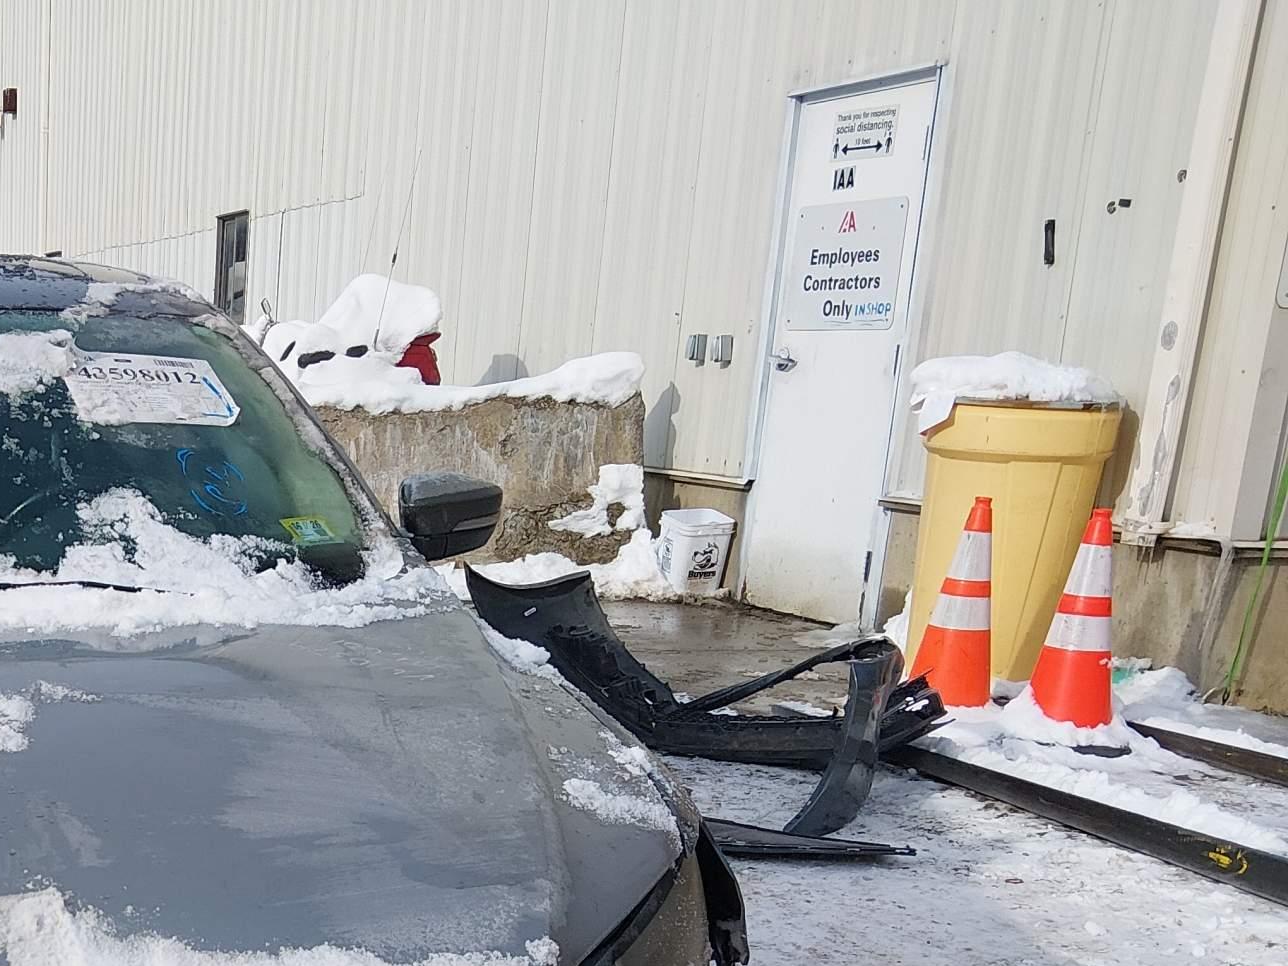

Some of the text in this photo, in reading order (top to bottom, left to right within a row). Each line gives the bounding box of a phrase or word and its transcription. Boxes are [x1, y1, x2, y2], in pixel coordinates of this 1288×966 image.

[853, 113, 861, 121] you
[870, 109, 896, 118] respecting
[836, 123, 855, 135] social
[833, 167, 854, 190] IAA
[810, 247, 880, 268] Employees
[803, 275, 881, 291] Contractors
[823, 299, 852, 320] Only
[78, 366, 201, 384] 43598012
[687, 570, 716, 579] Buyers
